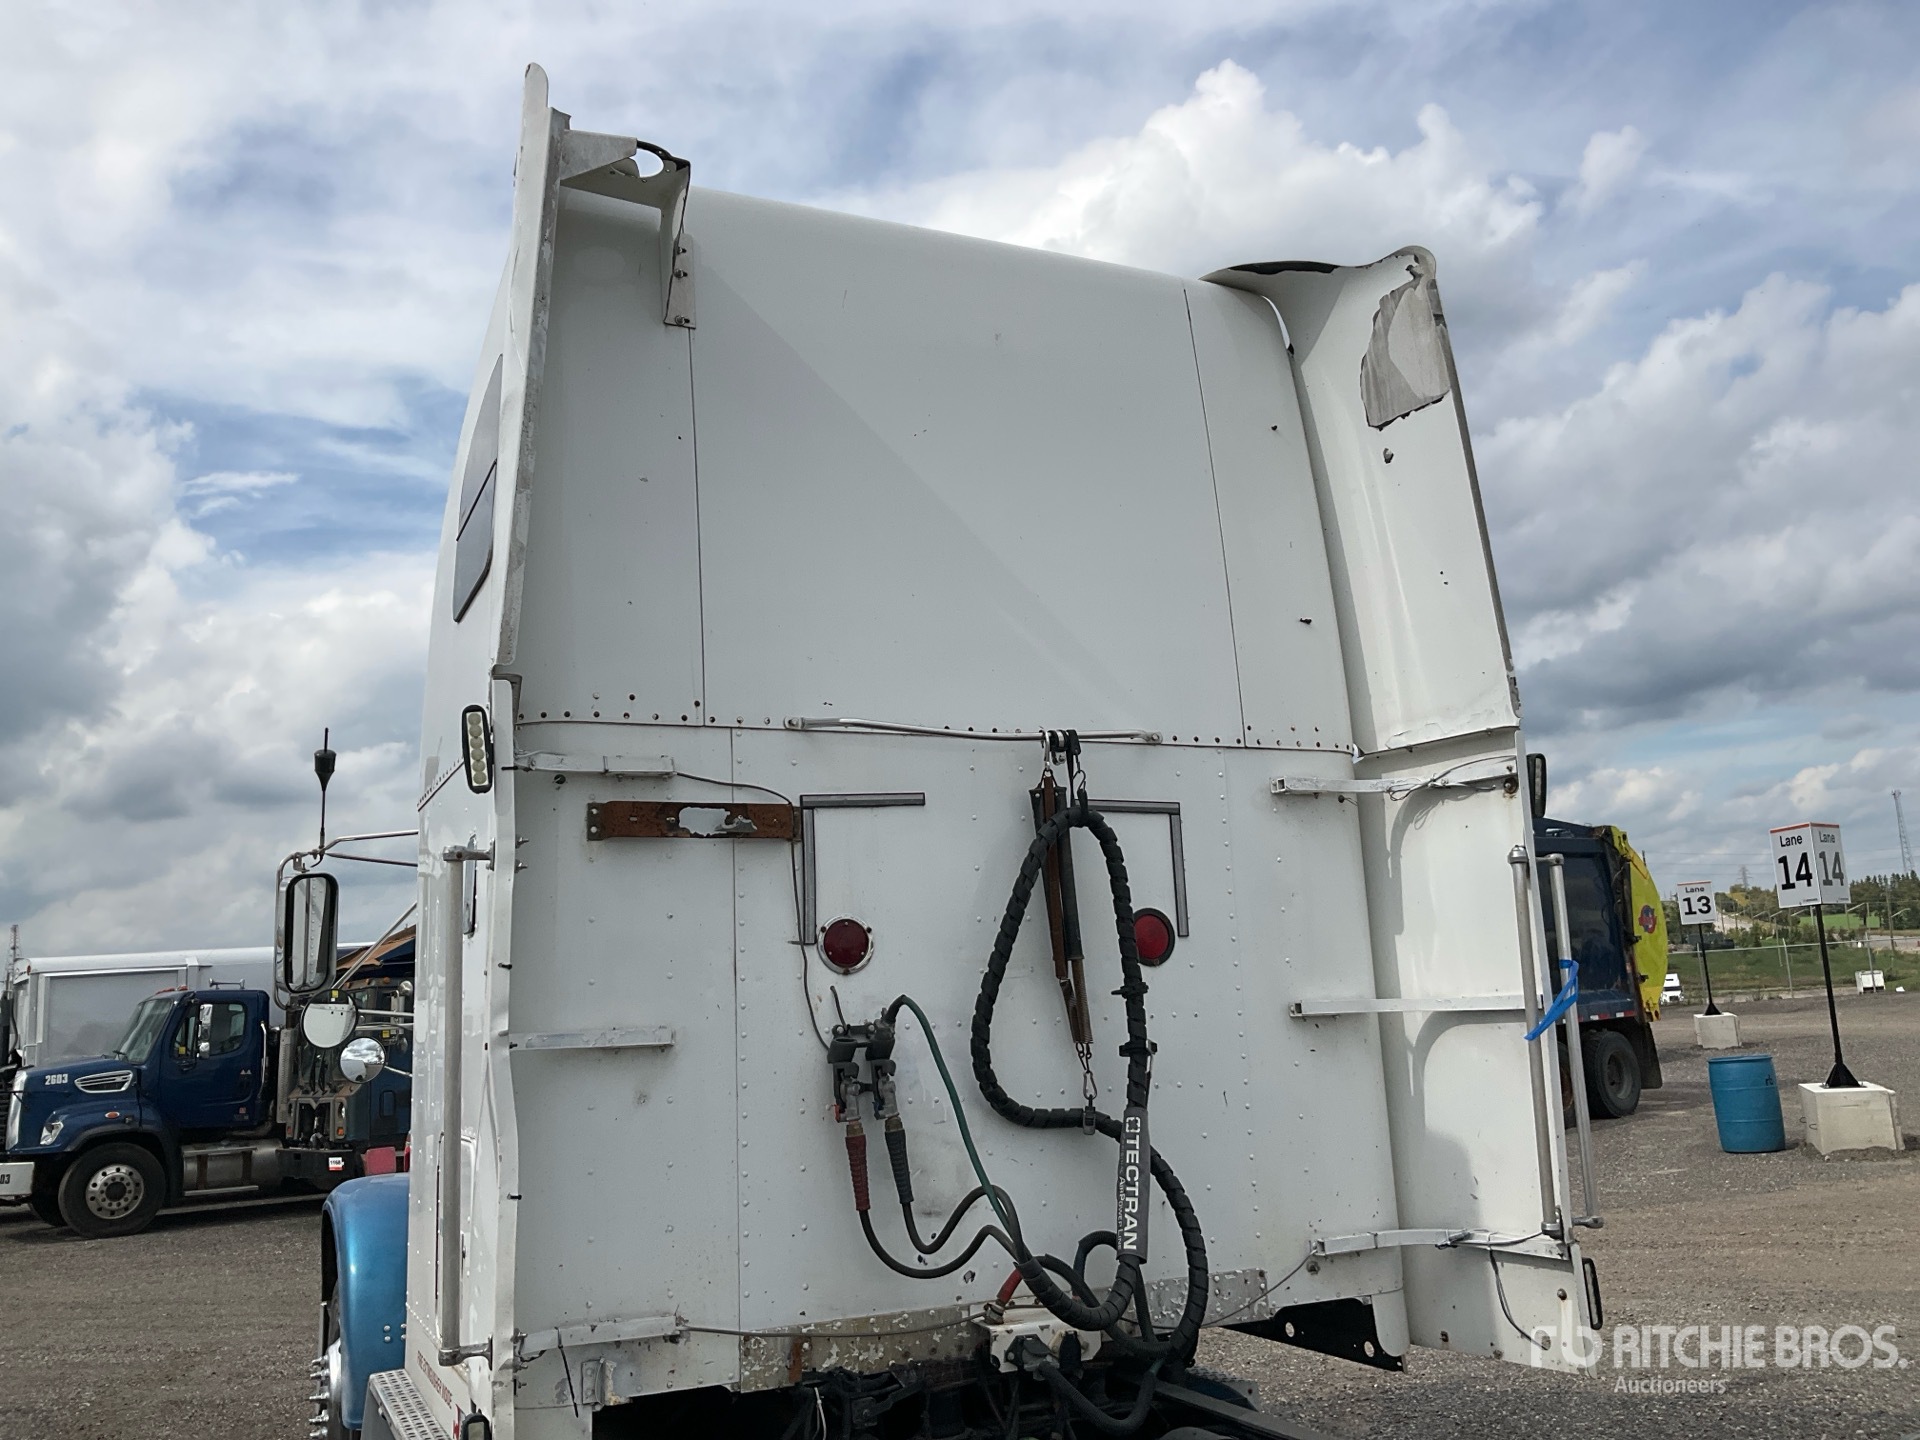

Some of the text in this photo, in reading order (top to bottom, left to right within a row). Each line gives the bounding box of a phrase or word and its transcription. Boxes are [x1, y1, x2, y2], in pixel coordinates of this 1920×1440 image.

[1780, 835, 1803, 847] Lane
[1819, 831, 1836, 843] Lane
[1778, 852, 1813, 890] 14
[1818, 851, 1844, 886] 14
[1682, 895, 1712, 916] 13
[45, 1073, 69, 1086] 2603
[1123, 1134, 1140, 1250] TECTRAN
